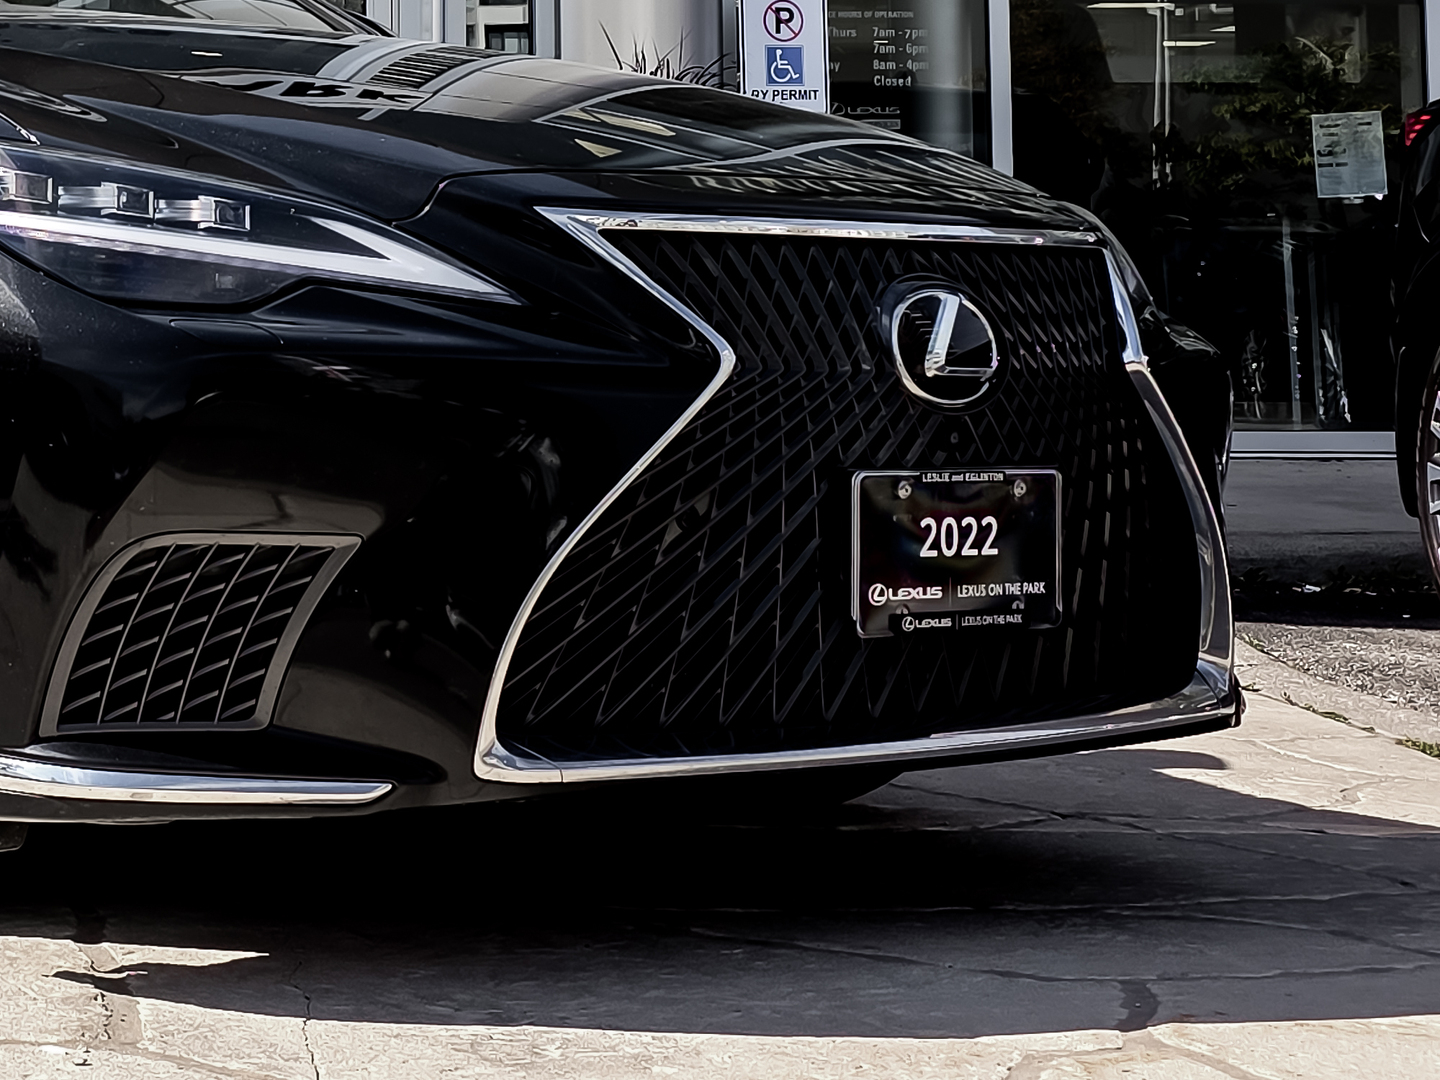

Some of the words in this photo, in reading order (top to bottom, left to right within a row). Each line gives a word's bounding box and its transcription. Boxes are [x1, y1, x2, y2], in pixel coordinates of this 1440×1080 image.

[872, 26, 896, 38] 7am
[873, 42, 896, 54] 7am
[873, 59, 896, 70] 8am
[873, 75, 912, 87] Closed
[771, 89, 820, 101] PERMIT
[847, 106, 901, 115] LEXUS
[919, 515, 999, 558] 2022
[888, 586, 943, 601] LEXUS
[957, 584, 987, 598] LEXUS
[988, 584, 1003, 596] ON
[1004, 583, 1021, 595] THE
[1022, 581, 1046, 594] PARK
[915, 618, 952, 628] LEXUS
[982, 615, 993, 625] ON
